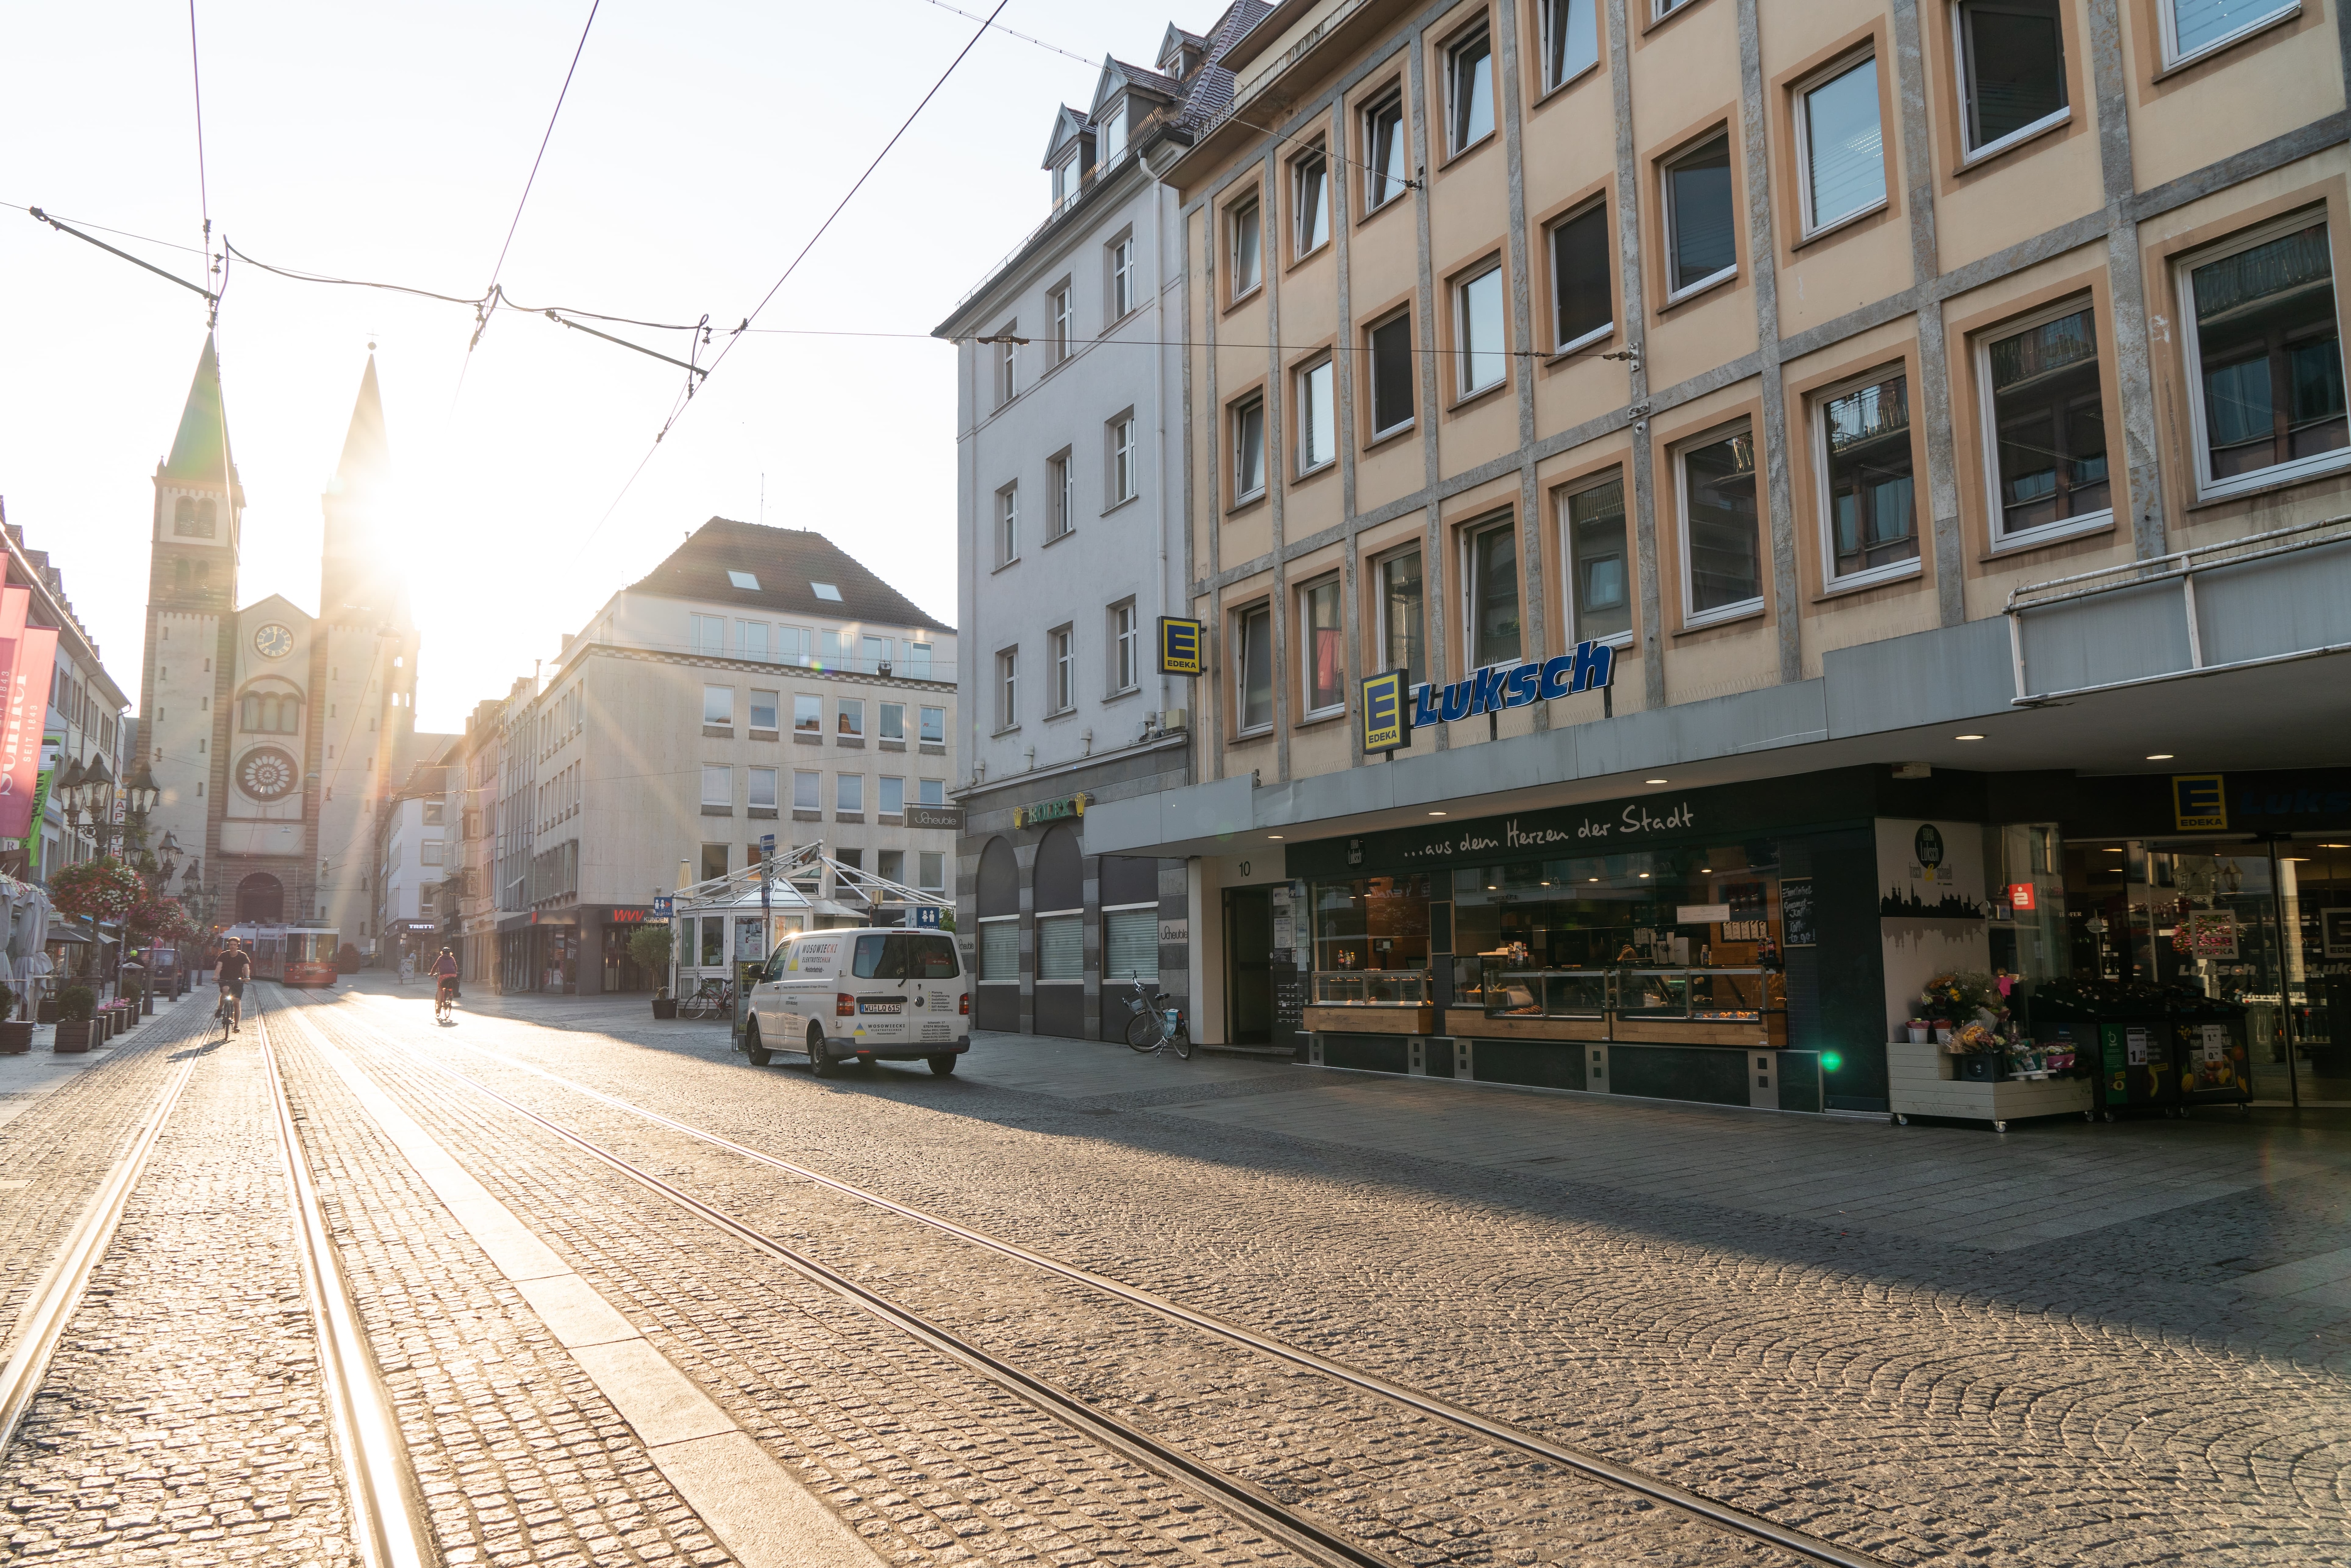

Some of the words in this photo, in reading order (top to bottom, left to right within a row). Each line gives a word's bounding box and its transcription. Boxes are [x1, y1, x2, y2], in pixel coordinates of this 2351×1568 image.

[1168, 660, 1196, 668] EDEKA
[1414, 640, 1614, 728] Luksch
[27, 705, 38, 730] 1843
[1369, 730, 1397, 744] EDEKA
[23, 737, 33, 762] SEIT
[915, 812, 957, 825] Scheuble
[1028, 799, 1071, 823] ROLEX
[1460, 833, 1499, 851] dem
[1507, 819, 1569, 848] Herzen
[1578, 818, 1610, 838] der
[1619, 802, 1694, 833] Stadt
[1923, 828, 1934, 841] EDEKA
[1350, 839, 1359, 849] EDEKA
[1920, 841, 1940, 861] Luksch
[1348, 849, 1362, 864] Luksch
[1239, 861, 1251, 877] 10
[1909, 862, 1922, 879] frisch
[1937, 863, 1952, 880] schnell
[614, 909, 644, 922] WVV
[1161, 926, 1188, 939] Scheuble
[802, 944, 838, 953] WOSOWIECKI
